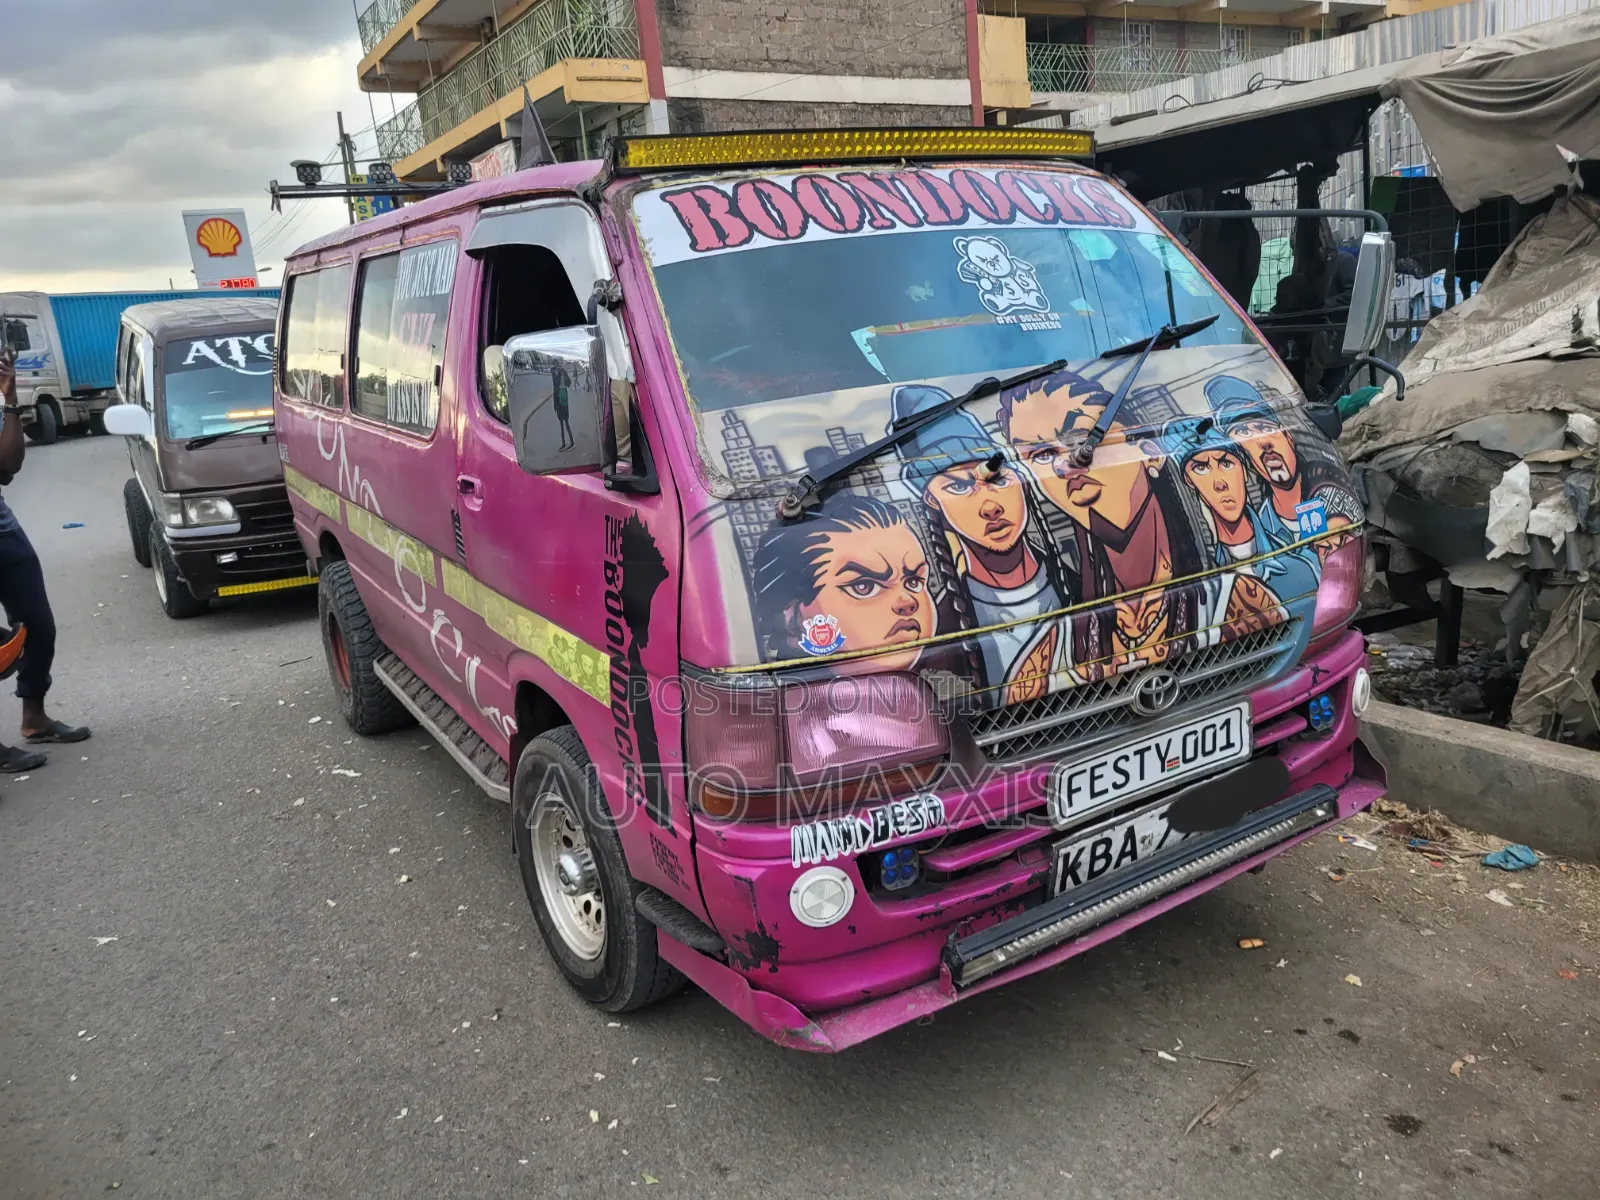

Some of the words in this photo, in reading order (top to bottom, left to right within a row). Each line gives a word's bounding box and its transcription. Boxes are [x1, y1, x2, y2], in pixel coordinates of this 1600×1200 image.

[661, 169, 1136, 252] BOONDOCKS
[1019, 313, 1047, 322] DOLLY
[1048, 311, 1061, 321] ON
[1020, 321, 1062, 332] BUSINESS
[810, 642, 839, 653] ARSENAL
[1067, 737, 1171, 808] FESTY
[1181, 716, 1236, 765] 001
[1058, 826, 1138, 893] KBA
